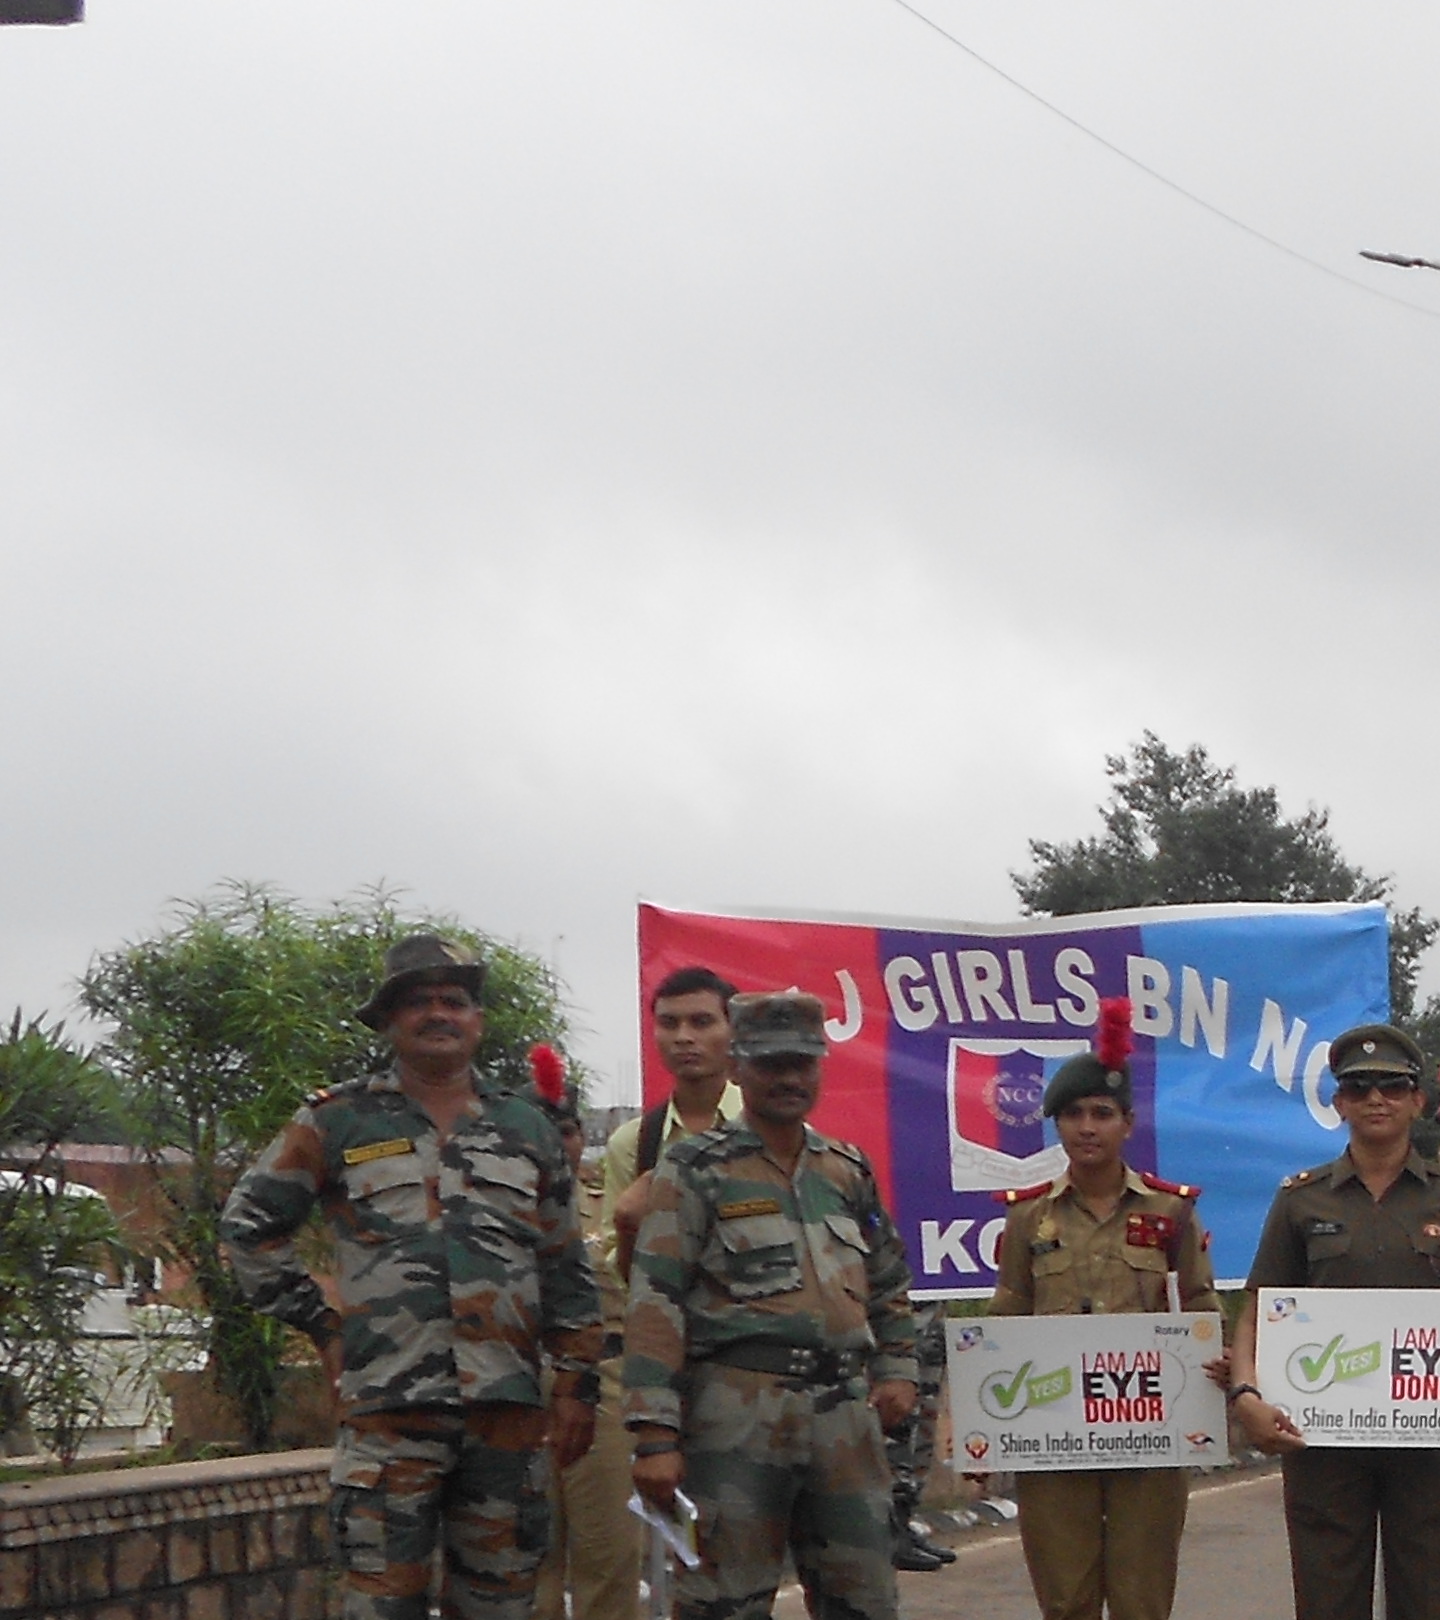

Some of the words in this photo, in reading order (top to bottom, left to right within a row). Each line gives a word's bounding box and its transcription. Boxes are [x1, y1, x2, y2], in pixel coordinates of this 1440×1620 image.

[884, 947, 1100, 1032] GIRLS
[1127, 955, 1230, 1059] BN
[999, 1086, 1040, 1103] NCC
[1154, 1325, 1190, 1336] Rotary
[1402, 1328, 1437, 1349] AM
[1093, 1352, 1126, 1372] AM
[1133, 1351, 1161, 1372] AN
[1082, 1371, 1163, 1398] EYE
[1084, 1398, 1164, 1424] DONOR
[1303, 1406, 1343, 1429] Shine
[1350, 1407, 1386, 1429] India
[1000, 1432, 1040, 1453] Shine
[1046, 1431, 1083, 1452] India
[1088, 1429, 1171, 1451] Foundation
